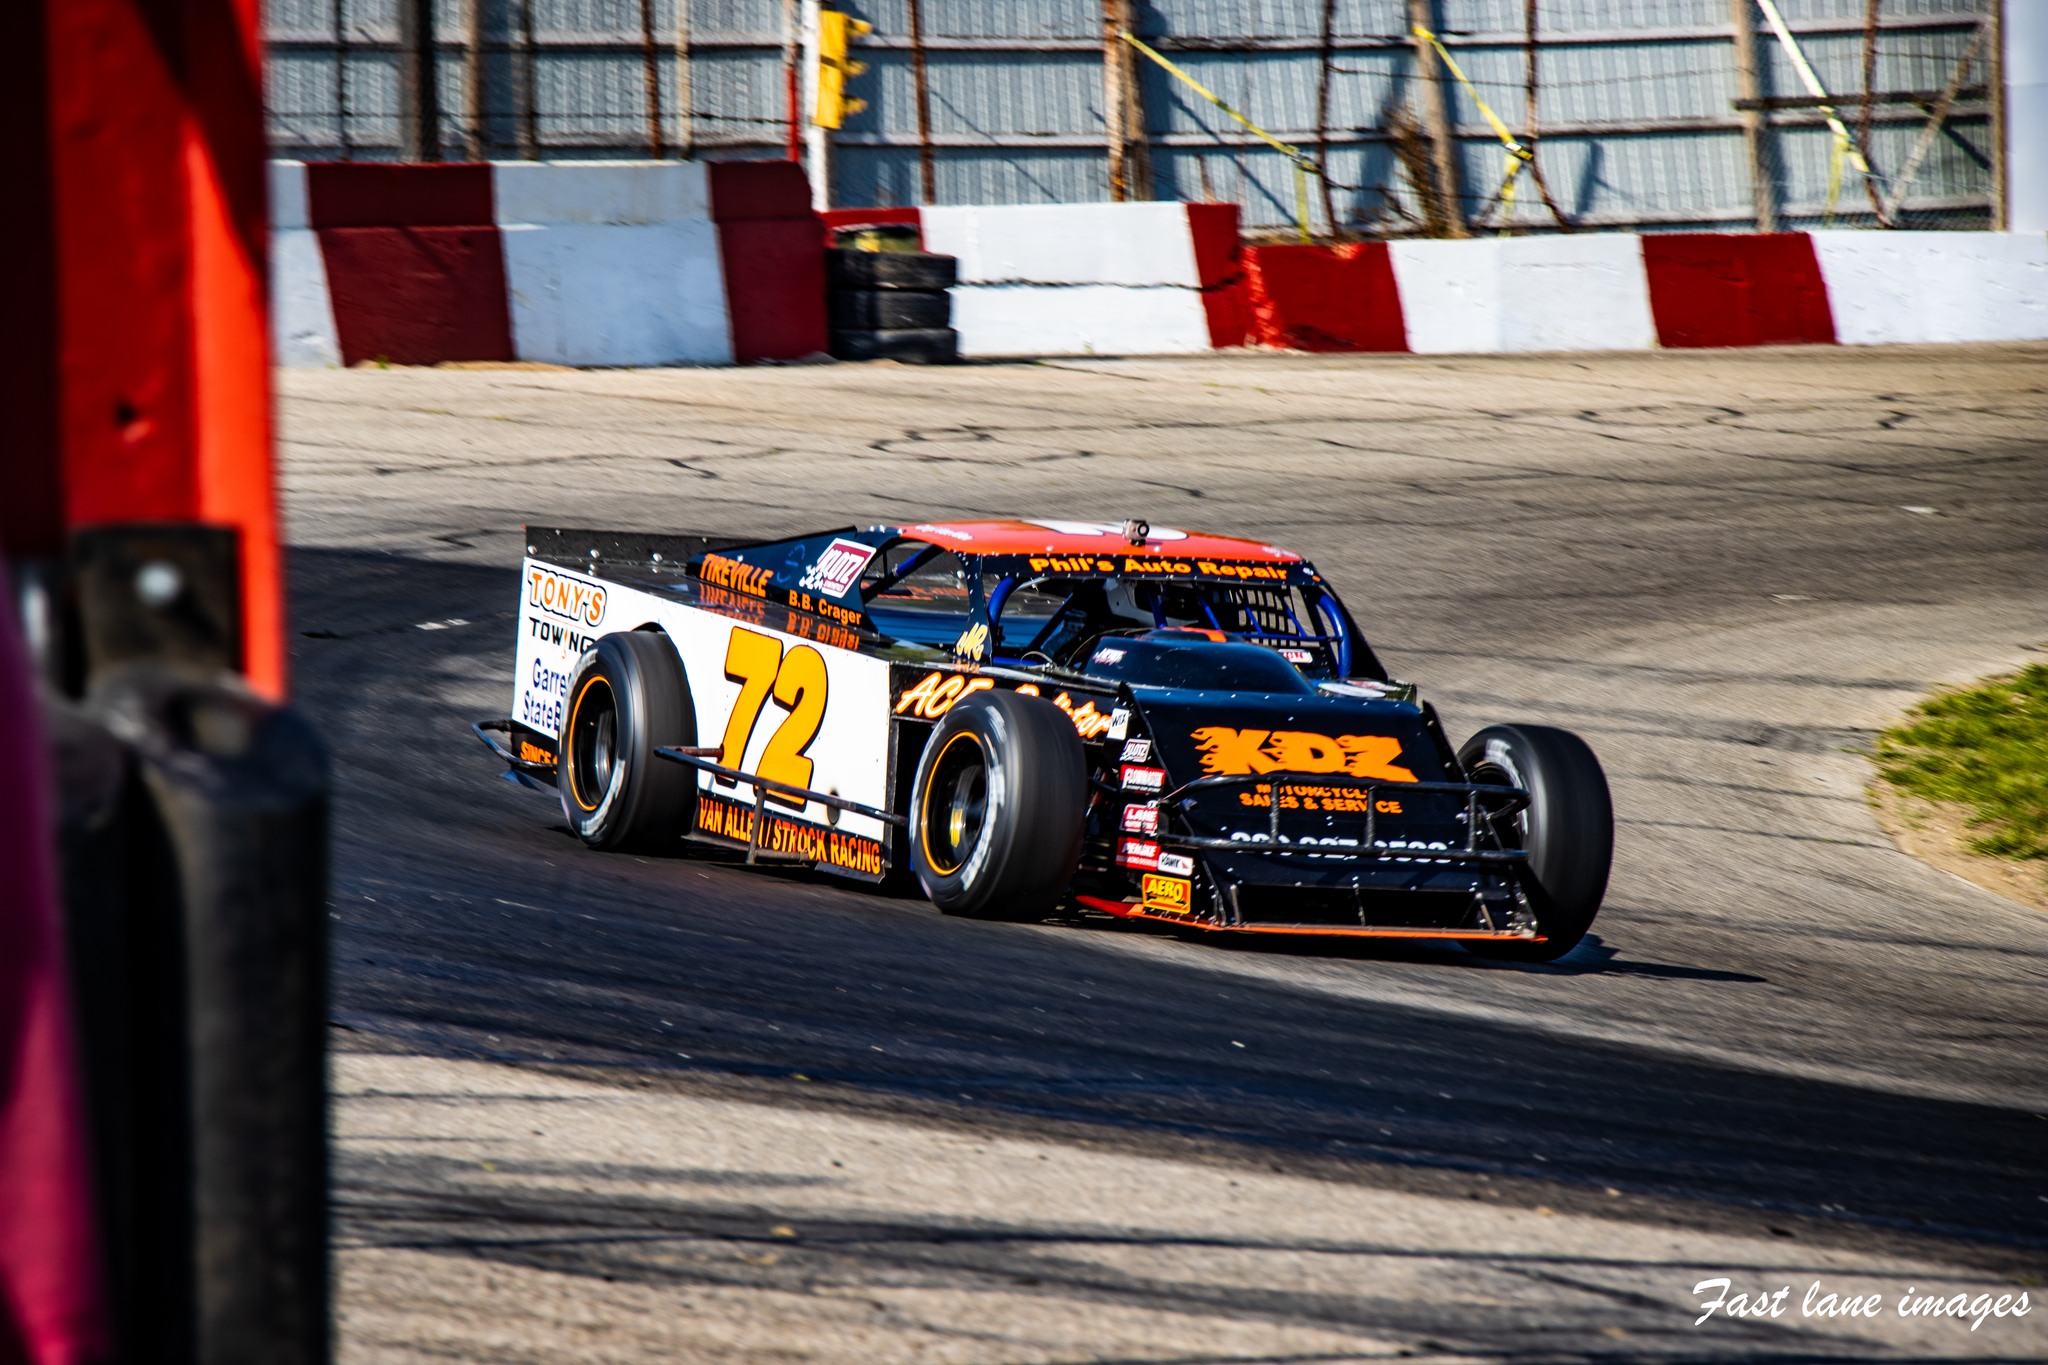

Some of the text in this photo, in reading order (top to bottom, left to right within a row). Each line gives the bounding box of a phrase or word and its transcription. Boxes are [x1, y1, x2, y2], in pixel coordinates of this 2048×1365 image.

[700, 553, 774, 598] TIREVILLE
[1029, 557, 1288, 580] Phil's Auto Repair
[531, 572, 604, 621] TONY'S
[789, 590, 814, 612] B.B.
[818, 601, 862, 625] Crager
[715, 626, 828, 812] 72
[1190, 727, 1419, 783] KDZ
[1303, 797, 1319, 810] &
[1323, 799, 1403, 814] SERVCE
[700, 797, 722, 835] VAN
[772, 819, 828, 862] STROCK
[830, 834, 881, 875] RACING
[1147, 878, 1184, 902] AERO
